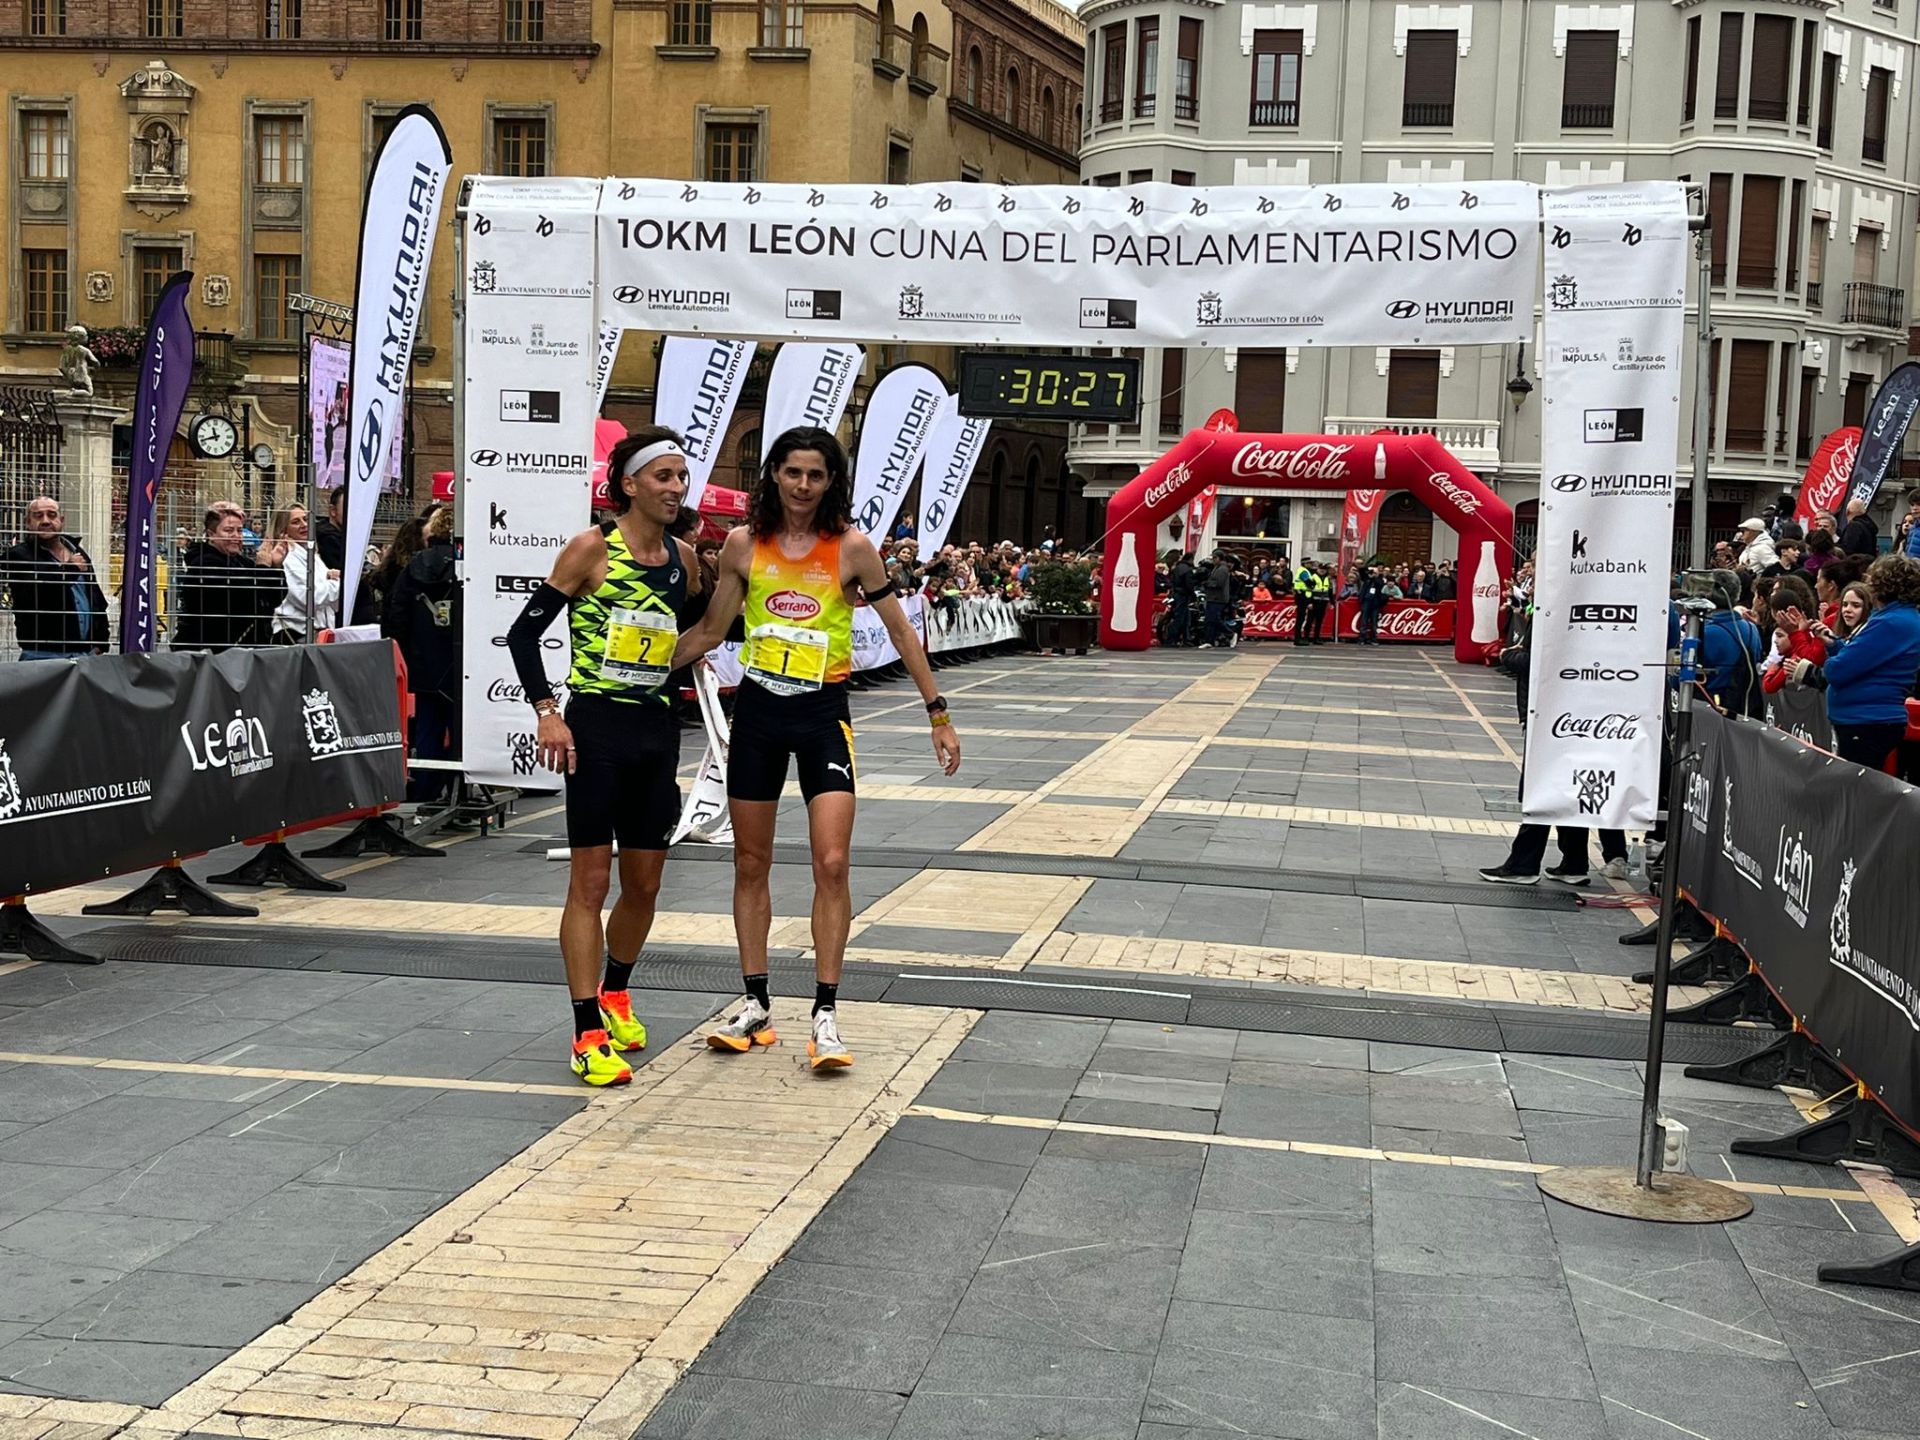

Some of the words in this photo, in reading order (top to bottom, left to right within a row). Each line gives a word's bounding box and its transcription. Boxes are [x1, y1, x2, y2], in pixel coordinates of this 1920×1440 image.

[618, 218, 727, 252] 10KM
[750, 217, 855, 257] LEÓN
[870, 228, 988, 262] CUNA
[1003, 231, 1077, 263] DEL
[1093, 228, 1517, 266] PARLAMENTARISMO
[377, 161, 431, 389] HYUNDAI
[389, 306, 414, 395] Lemauto
[411, 170, 439, 302] Automoción
[498, 286, 556, 295] AYUNTAMIENTO
[571, 286, 591, 296] LEÓN
[648, 288, 729, 306] HYUNDAI
[682, 305, 729, 313] Automoción
[789, 300, 811, 308] LEÓN
[1426, 300, 1513, 317] HYUNDAI
[1580, 298, 1647, 308] AYUNTAMIENTO
[1649, 297, 1659, 305] DE
[1659, 296, 1682, 305] LEÓN
[925, 311, 985, 320] AYUNTAMIENTO
[988, 313, 999, 321] DE
[1000, 312, 1022, 322] LEÓN
[1083, 307, 1106, 317] LEÓN
[1223, 316, 1287, 324] AYUNTAMIENTO
[1302, 315, 1324, 323] LEÓN
[1425, 316, 1461, 324] Lemauto
[1463, 315, 1513, 323] Automoción
[482, 336, 522, 346] IMPULSA
[1562, 353, 1607, 364] IMPULSA
[1612, 363, 1640, 371] Castilla
[504, 399, 527, 410] LEÓN
[1588, 419, 1614, 430] LEÓN
[698, 405, 723, 463] Lemauto
[876, 388, 933, 492] HYUNDAI
[891, 454, 915, 496] Lemauto
[911, 395, 941, 455] Automoción
[507, 452, 587, 468] HYUNDAI
[939, 417, 980, 496] HYUNDA
[1232, 441, 1354, 480] Coca-Cola
[541, 467, 587, 475] Automoción
[1145, 461, 1192, 508] Coca-Cola
[1592, 474, 1672, 489] HYUNDAI
[1428, 471, 1484, 514] Coca-Cola
[489, 532, 567, 547] kutxabank
[1570, 558, 1647, 575] kutxabank
[498, 577, 542, 591] LEO
[771, 598, 816, 613] Serrano
[1571, 607, 1635, 620] LEON
[1568, 624, 1637, 632] PLAZA
[638, 637, 651, 663] 2
[781, 650, 789, 675] 1
[1559, 662, 1639, 682] emico
[1552, 712, 1641, 740] Coca-Cola
[1573, 769, 1616, 786] KAM
[24, 785, 107, 813] AYUNTAMIENTO
[109, 783, 125, 797] DE
[127, 776, 151, 796] LEÓN
[1577, 786, 1610, 801] ARI
[1580, 800, 1608, 814] NY
[1852, 949, 1905, 999] AYUNTAMIENTO
